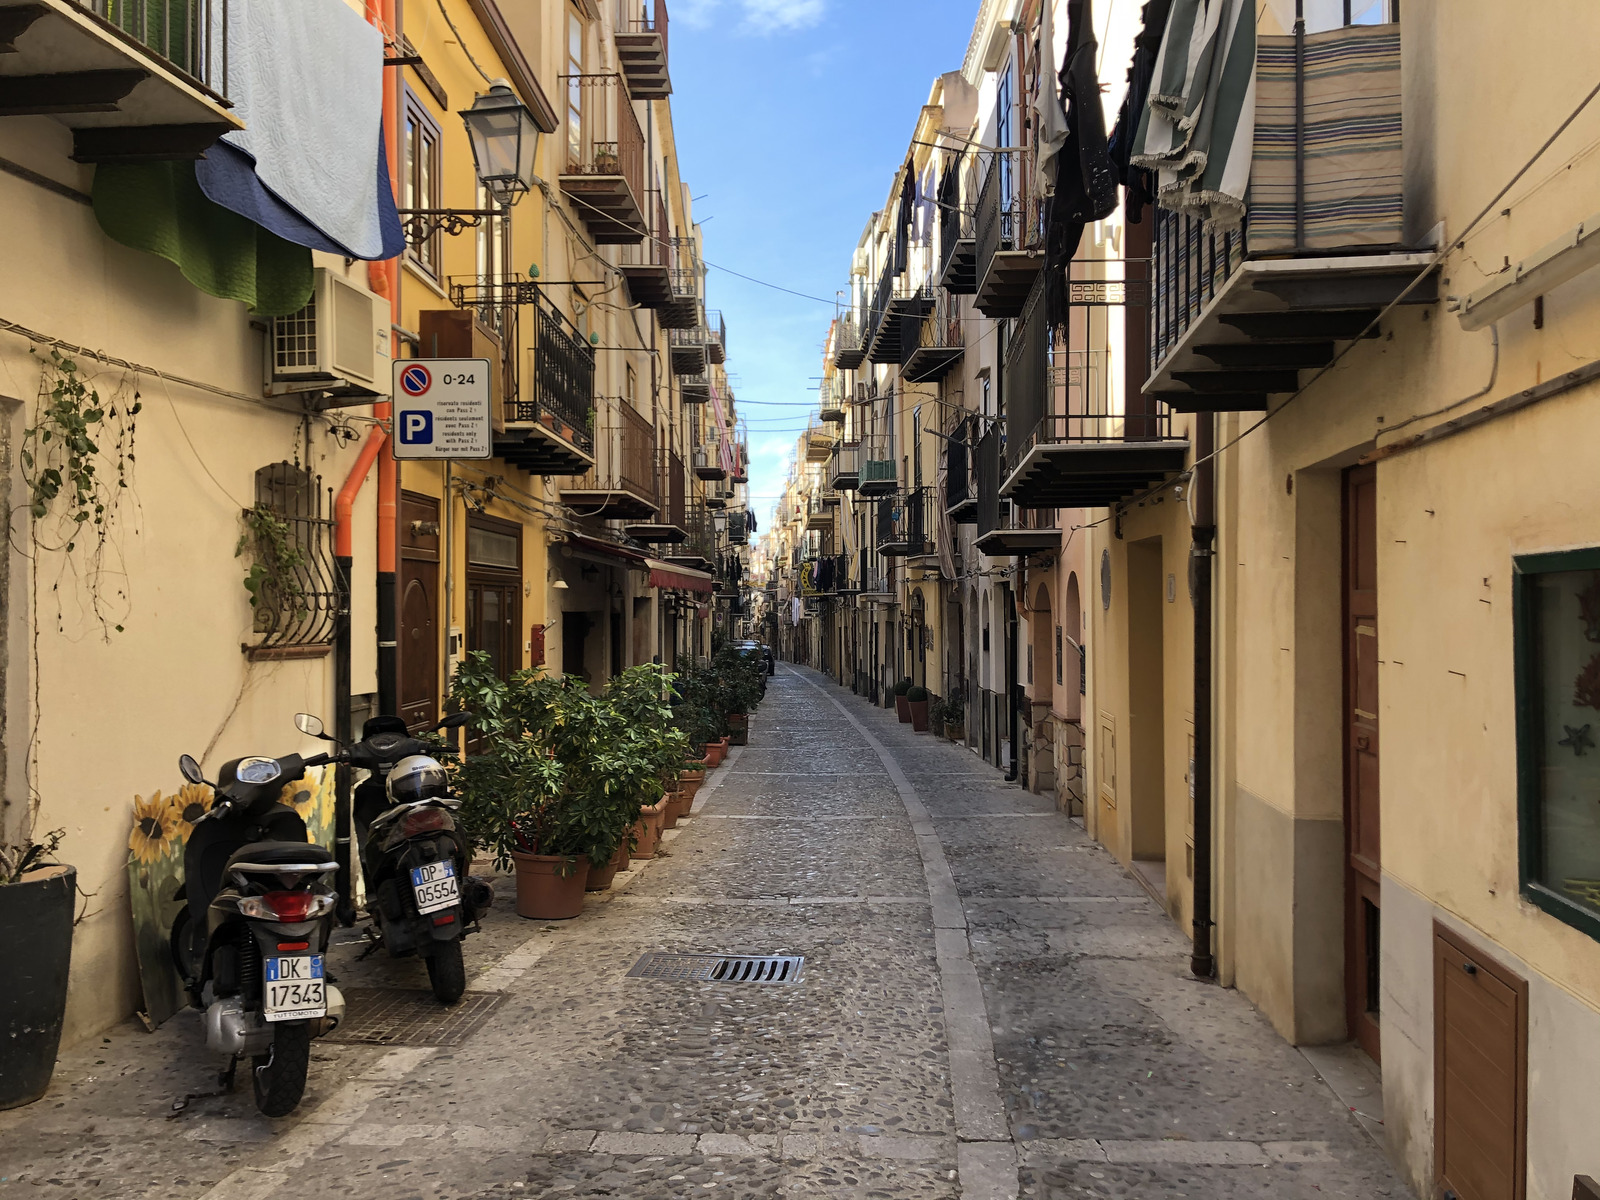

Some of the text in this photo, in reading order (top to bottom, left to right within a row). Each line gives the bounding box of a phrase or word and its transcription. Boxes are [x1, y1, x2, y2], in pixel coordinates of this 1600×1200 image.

[443, 374, 475, 385] 0-24
[406, 414, 426, 440] P
[421, 865, 437, 882] DP
[417, 879, 457, 904] 05554
[280, 958, 300, 978] DK
[271, 983, 322, 1007] 17343
[273, 1010, 319, 1019] TUTTOMOTO
